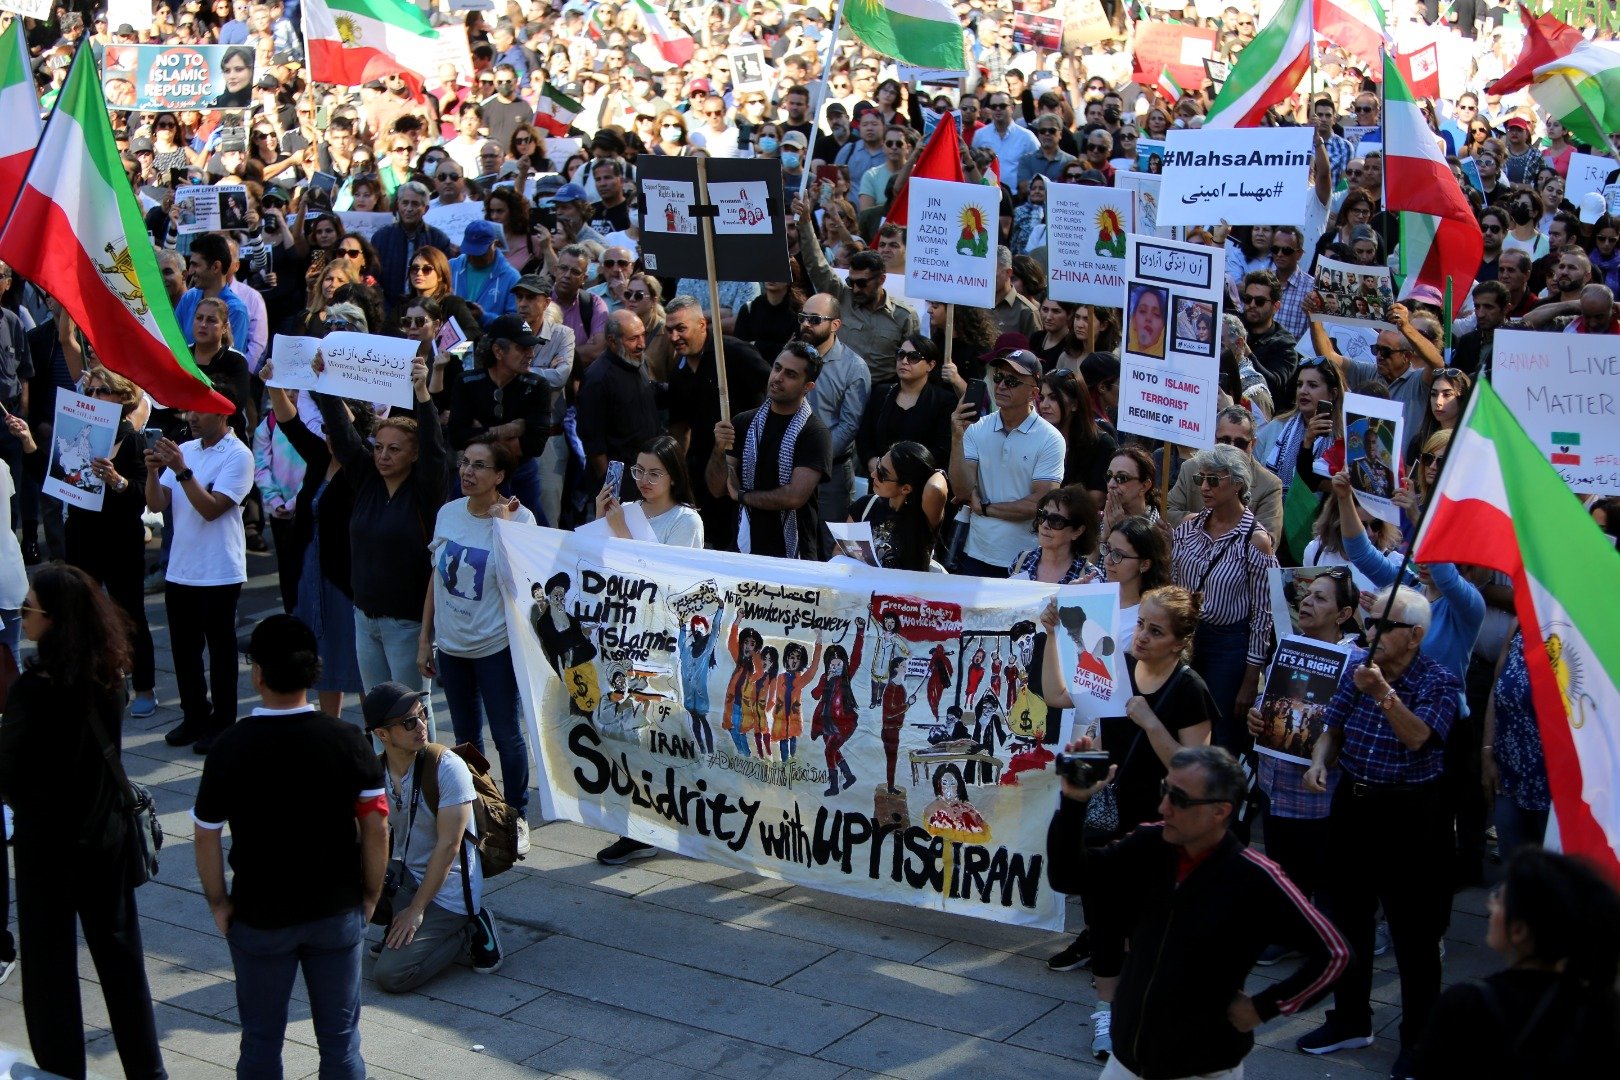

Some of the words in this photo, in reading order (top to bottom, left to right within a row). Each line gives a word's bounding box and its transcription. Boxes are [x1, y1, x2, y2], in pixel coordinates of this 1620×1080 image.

[156, 54, 180, 67] NO
[183, 54, 204, 66] TO
[150, 69, 208, 82] ISLAMIC
[144, 83, 212, 97] REPUBLIC
[1162, 150, 1313, 167] #MahsaAmini
[927, 197, 941, 207] JIN
[921, 211, 946, 221] JIYAN
[1051, 208, 1085, 216] OPPRESSION
[919, 224, 947, 236] AZADI
[1064, 225, 1087, 233] WOMEN
[916, 235, 948, 246] WOMAN
[924, 247, 939, 255] LIFE
[913, 256, 949, 267] FREEDOM
[1063, 260, 1077, 268] SAY
[1078, 261, 1093, 269] HER
[1095, 263, 1118, 272] NAME
[921, 270, 954, 284] ZHINA
[957, 275, 988, 288] AMINI
[1051, 268, 1090, 283] ZHINA
[1094, 273, 1125, 287] AMIN
[1132, 370, 1145, 382] NO
[1146, 373, 1158, 385] TO
[1165, 377, 1200, 395] ISLAMIC
[76, 400, 96, 412] IRAN
[1141, 391, 1188, 412] TERRORIST
[1527, 386, 1616, 416] MATTER
[1129, 406, 1160, 423] REGIME
[1161, 413, 1174, 425] OF
[1178, 418, 1200, 432] IRAN
[582, 570, 658, 604] Down
[574, 597, 637, 625] with
[879, 600, 918, 615] Freedom
[801, 609, 851, 644] Slavery
[1279, 653, 1297, 664] IT'S
[1297, 658, 1304, 667] A
[1307, 659, 1339, 675] RIGHT
[1073, 675, 1112, 697] SURVIVE
[1076, 667, 1090, 679] WE
[1093, 674, 1113, 689] WILL
[658, 705, 671, 722] OF
[650, 729, 695, 760] IRAN
[949, 841, 1043, 909] IRAN
